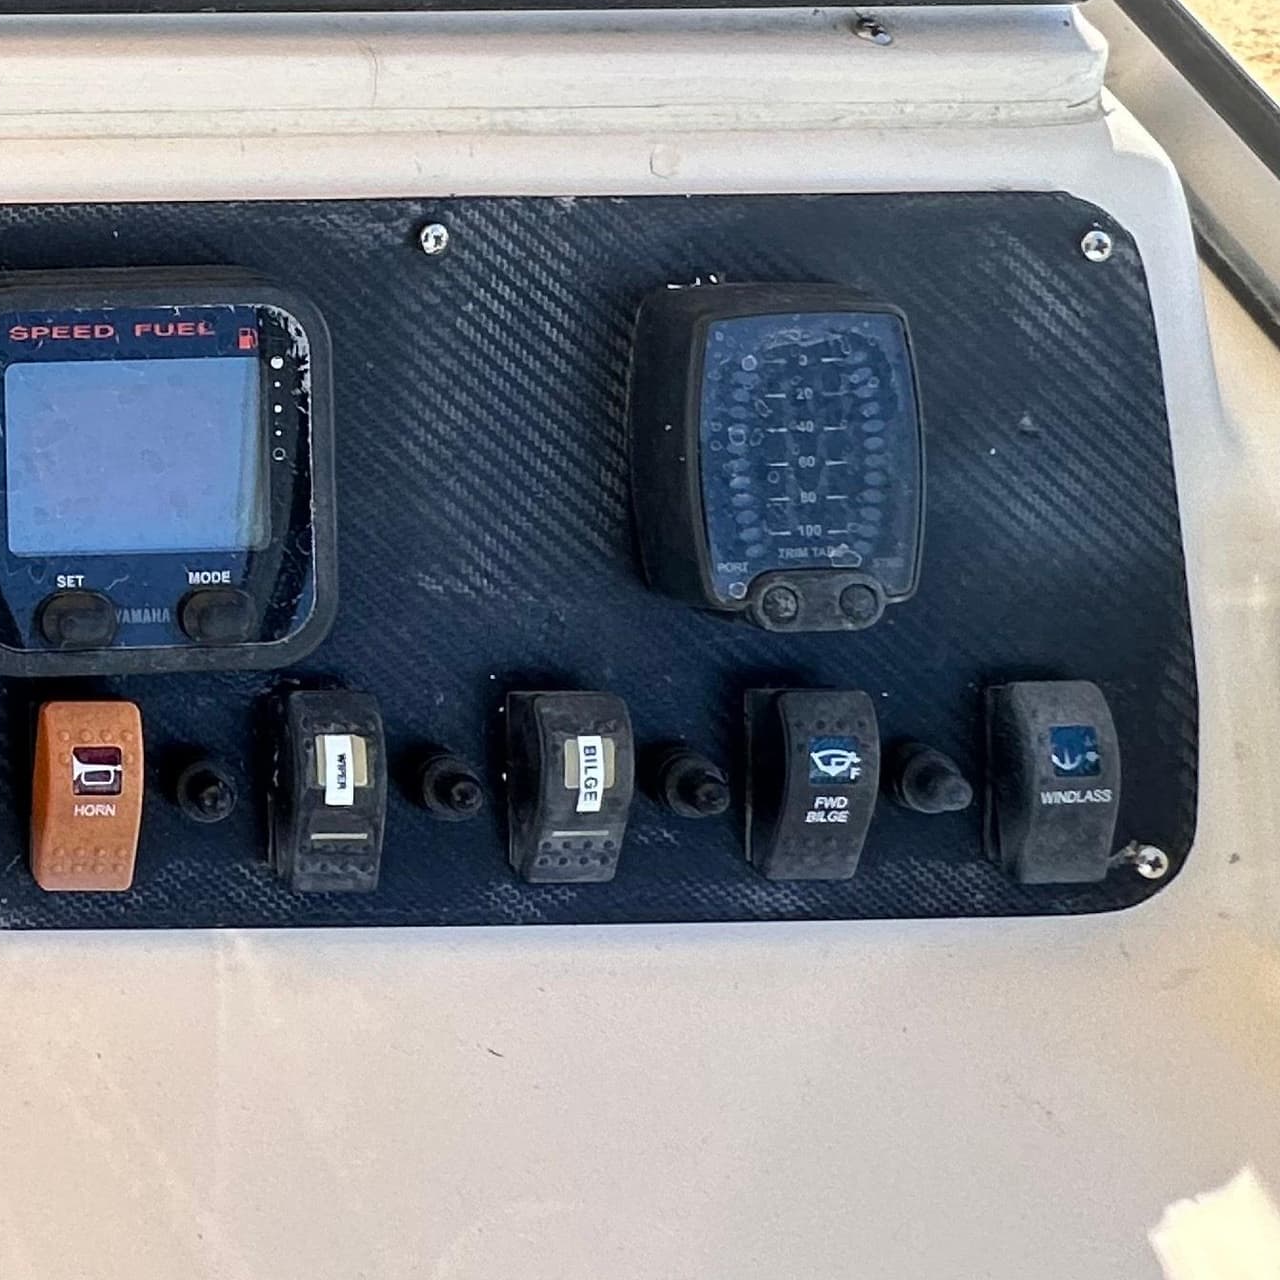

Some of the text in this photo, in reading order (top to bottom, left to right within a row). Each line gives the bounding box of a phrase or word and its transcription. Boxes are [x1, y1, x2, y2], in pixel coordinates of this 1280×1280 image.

[8, 321, 216, 341] SPEED FUEL
[795, 386, 814, 401] 20
[796, 523, 825, 538] 100
[777, 546, 810, 560] TRIM
[56, 574, 85, 588] SET
[187, 570, 231, 585] MODE
[116, 607, 171, 624] YAMAHA
[583, 744, 599, 803] BILGE
[814, 796, 849, 809] FWD
[1040, 788, 1113, 805] WINDLASS
[73, 803, 117, 817] HORN
[806, 810, 849, 823] BILGE
